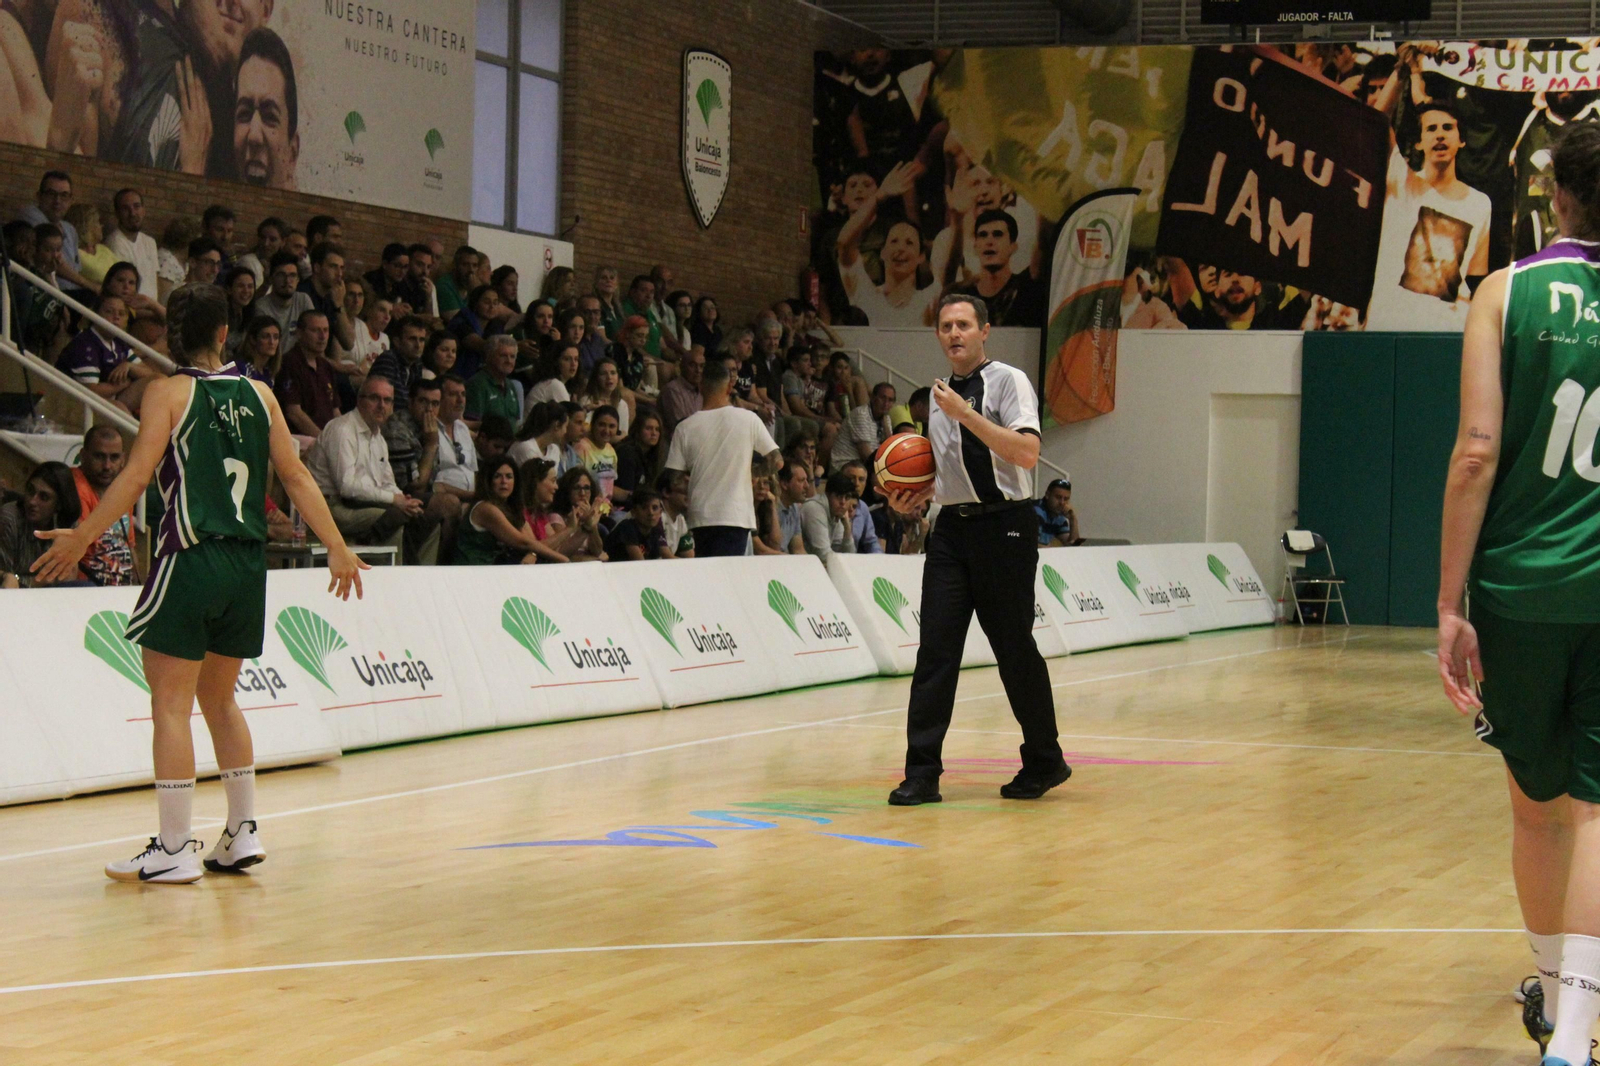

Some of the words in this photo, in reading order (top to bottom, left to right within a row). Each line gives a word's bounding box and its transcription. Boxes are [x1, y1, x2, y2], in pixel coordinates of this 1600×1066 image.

[325, 0, 394, 33] NUESTRA
[403, 19, 466, 53] CANTERA
[1277, 12, 1319, 22] JUGADOR
[1328, 12, 1354, 21] FALTA
[344, 37, 398, 63] NUESTRO
[405, 52, 448, 76] FUTURO
[1494, 48, 1600, 74] UNIC
[695, 136, 721, 161] Unicaja
[1538, 330, 1580, 344] Ciudad
[222, 457, 249, 524] 7
[1142, 585, 1171, 608] Unicaja
[1168, 581, 1191, 602] nicaja
[1232, 576, 1261, 596] Unicaja
[1071, 590, 1104, 615] Unicaja
[686, 623, 738, 657] Unicaja
[806, 613, 852, 643] Unicaja
[351, 649, 433, 691] Unicaja
[563, 637, 632, 674] Unicaja
[235, 659, 287, 700] caja
